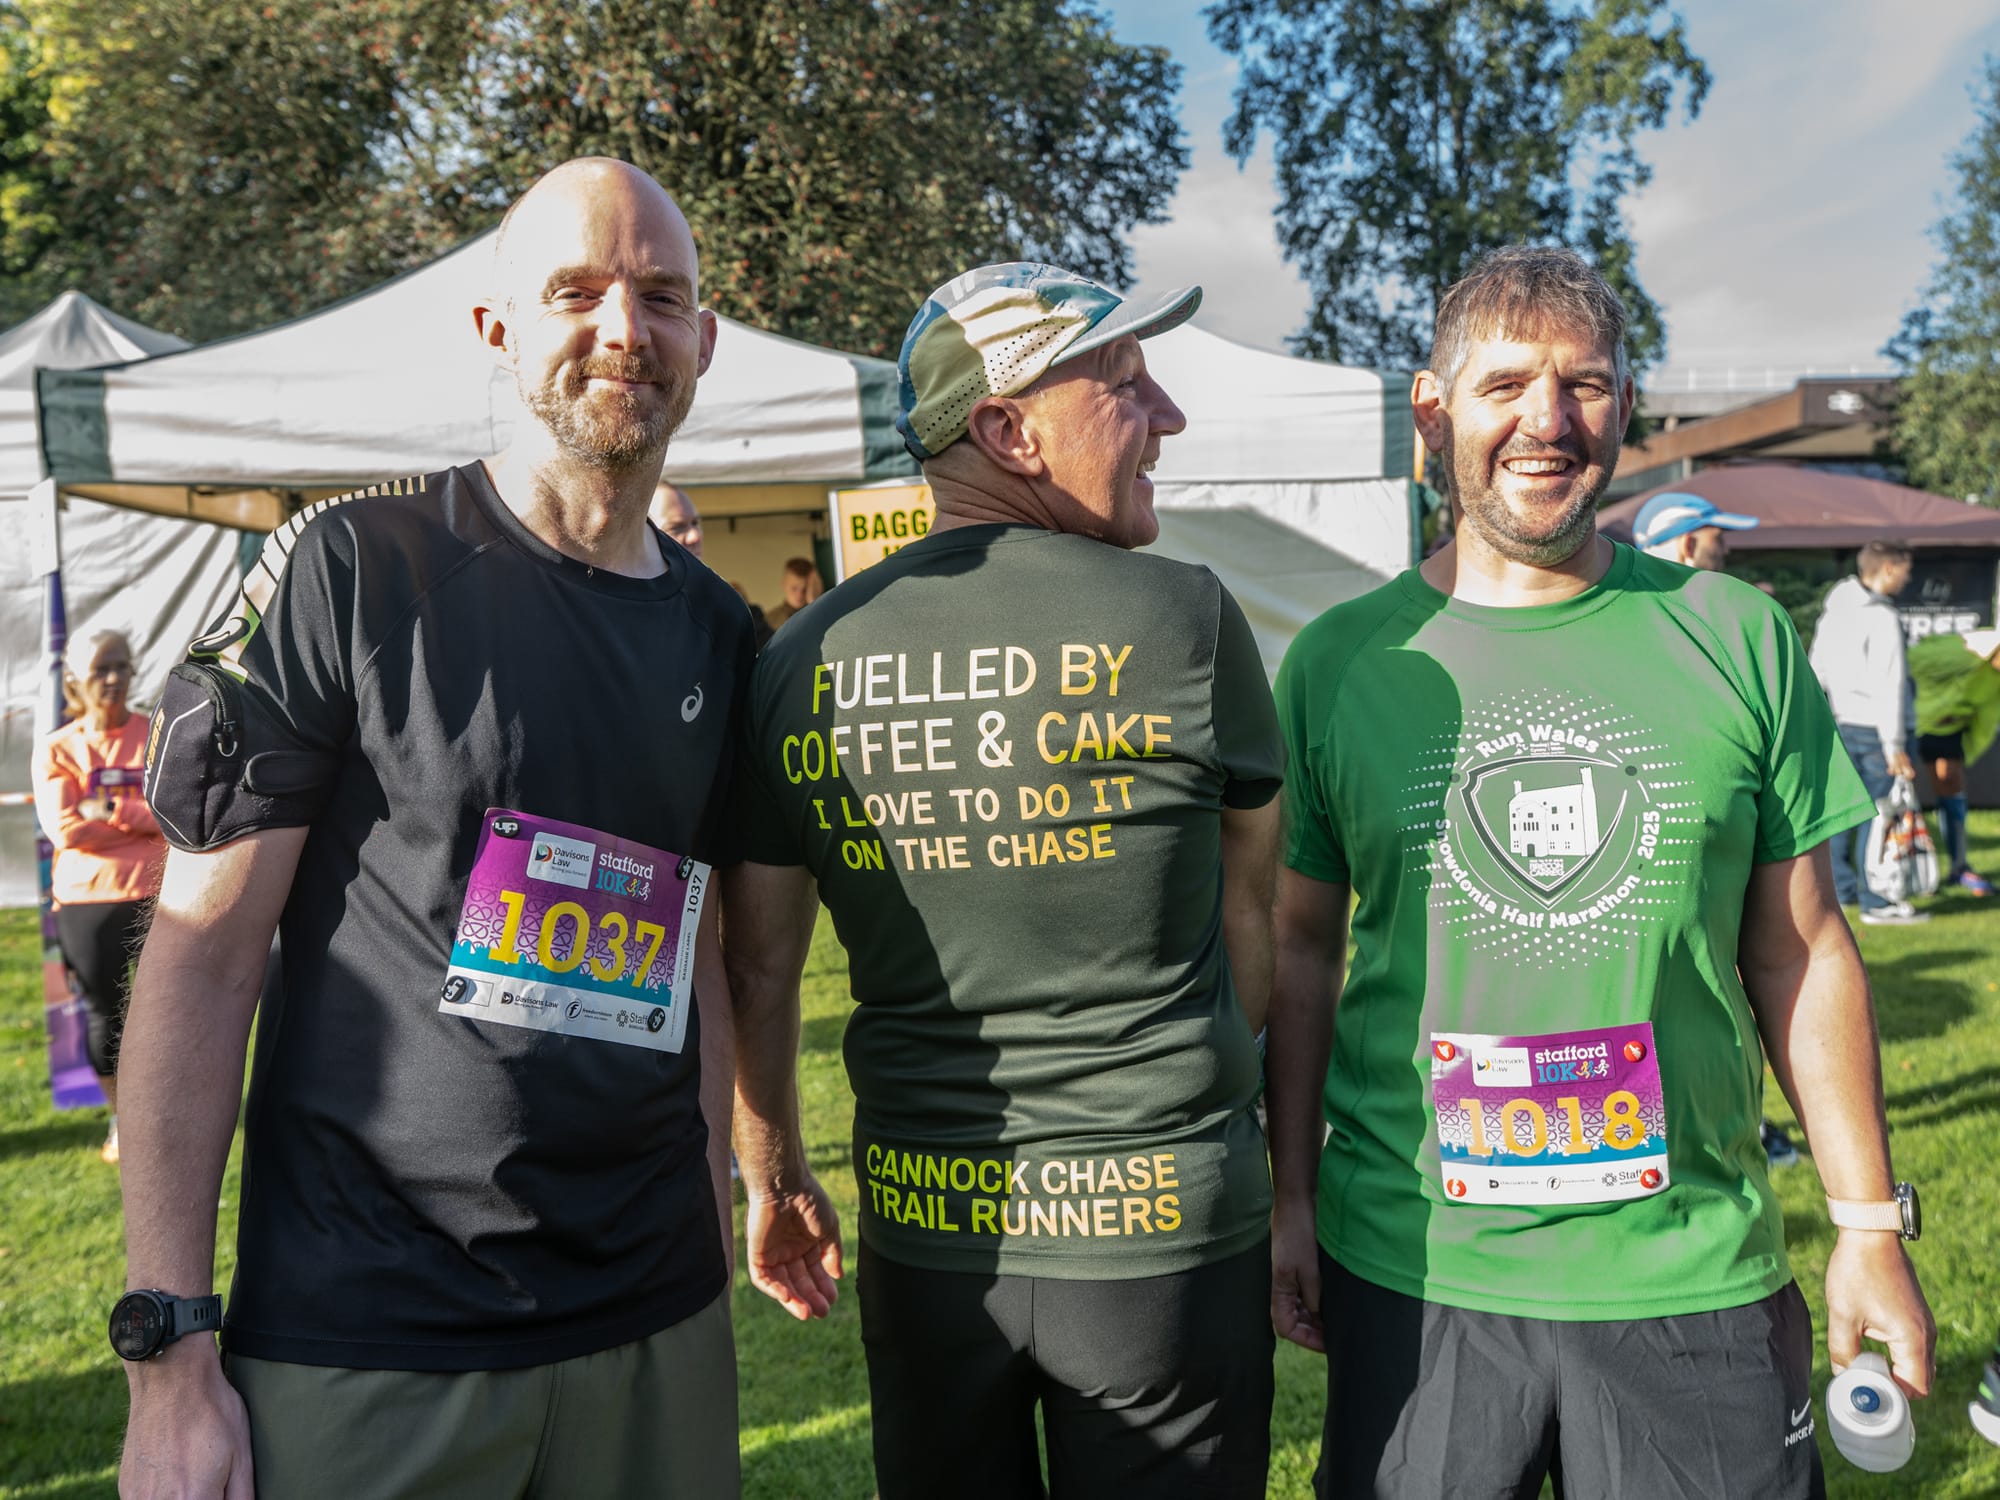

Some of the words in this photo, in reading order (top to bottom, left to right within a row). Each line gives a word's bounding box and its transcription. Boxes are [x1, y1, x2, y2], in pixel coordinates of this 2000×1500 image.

[851, 509, 929, 542] BAGG
[812, 646, 1037, 714] FUELLED
[1060, 644, 1134, 697] BY
[782, 717, 957, 784] COFFEE
[977, 710, 1014, 768] &
[1036, 711, 1173, 764] CAKE
[1475, 730, 1525, 758] Run
[1527, 724, 1600, 754] Wales
[812, 799, 832, 830] I
[842, 791, 936, 828] LOVE
[949, 788, 1000, 822] TO
[1018, 783, 1071, 821] DO
[1090, 776, 1135, 814] IT
[552, 857, 571, 868] Law
[554, 847, 590, 862] Davisons
[842, 839, 885, 871] ON
[895, 836, 972, 871] THE
[987, 823, 1116, 868] CHASE
[595, 868, 629, 896] 10K
[599, 852, 654, 880] stafford
[1435, 818, 1498, 914] Snowdonia
[1501, 904, 1544, 928] Half
[1549, 874, 1640, 929] Marathon
[1637, 810, 1661, 860] 2025
[687, 874, 703, 915] 1037
[488, 890, 665, 988] 1037
[514, 996, 545, 1006] Davisons
[545, 1000, 559, 1009] Law
[630, 1012, 649, 1025] Staff
[1534, 1042, 1608, 1065] stafford
[1536, 1062, 1579, 1083] 10K
[1460, 1090, 1646, 1158] 1018
[866, 1144, 1031, 1195] CANNOCK
[1041, 1153, 1179, 1195] CHASE
[1619, 1169, 1642, 1180] Staff
[867, 1178, 959, 1232] TRAIL
[971, 1193, 1182, 1237] RUNNERS
[1785, 1426, 1808, 1447] NIKE
